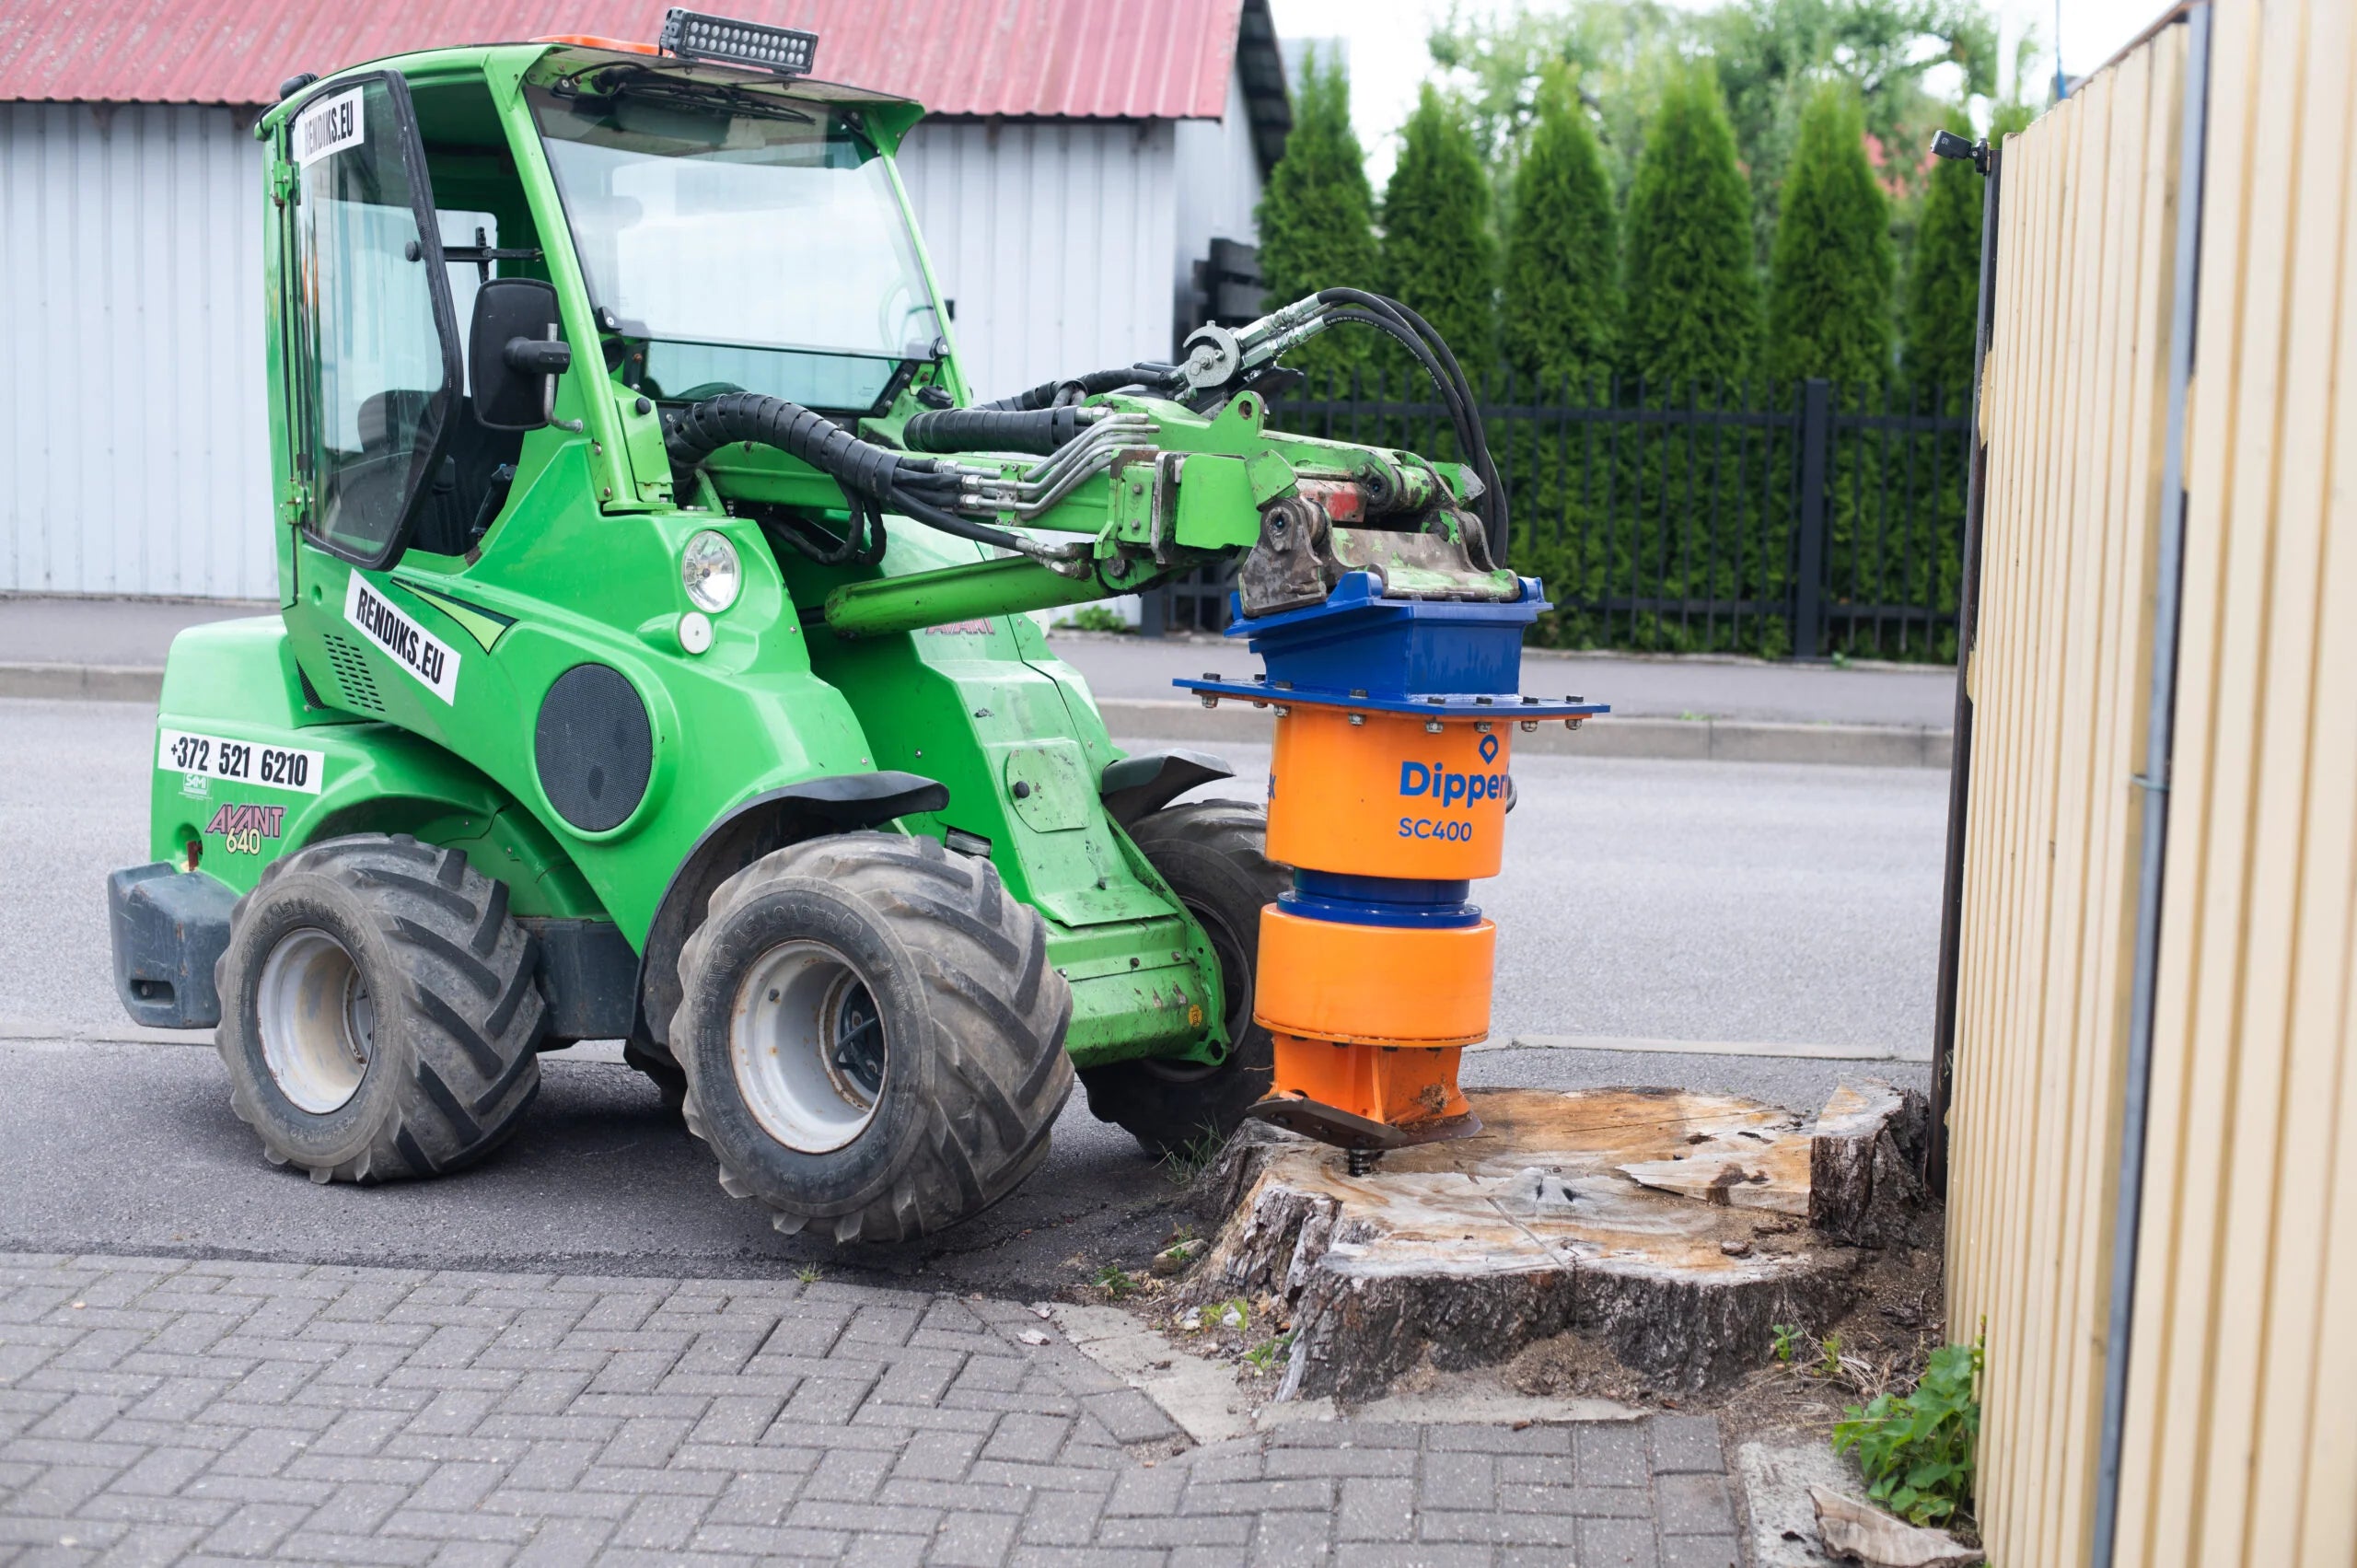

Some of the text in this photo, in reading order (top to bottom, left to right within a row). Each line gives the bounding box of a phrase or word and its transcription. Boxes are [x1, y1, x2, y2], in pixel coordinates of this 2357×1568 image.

[355, 587, 445, 685] RENDIKS.EU
[170, 736, 308, 787] +372 521 6210
[1399, 761, 1509, 807] Dipper
[204, 804, 285, 838] AVANT
[226, 827, 261, 855] 640
[1399, 818, 1472, 842] SC400
